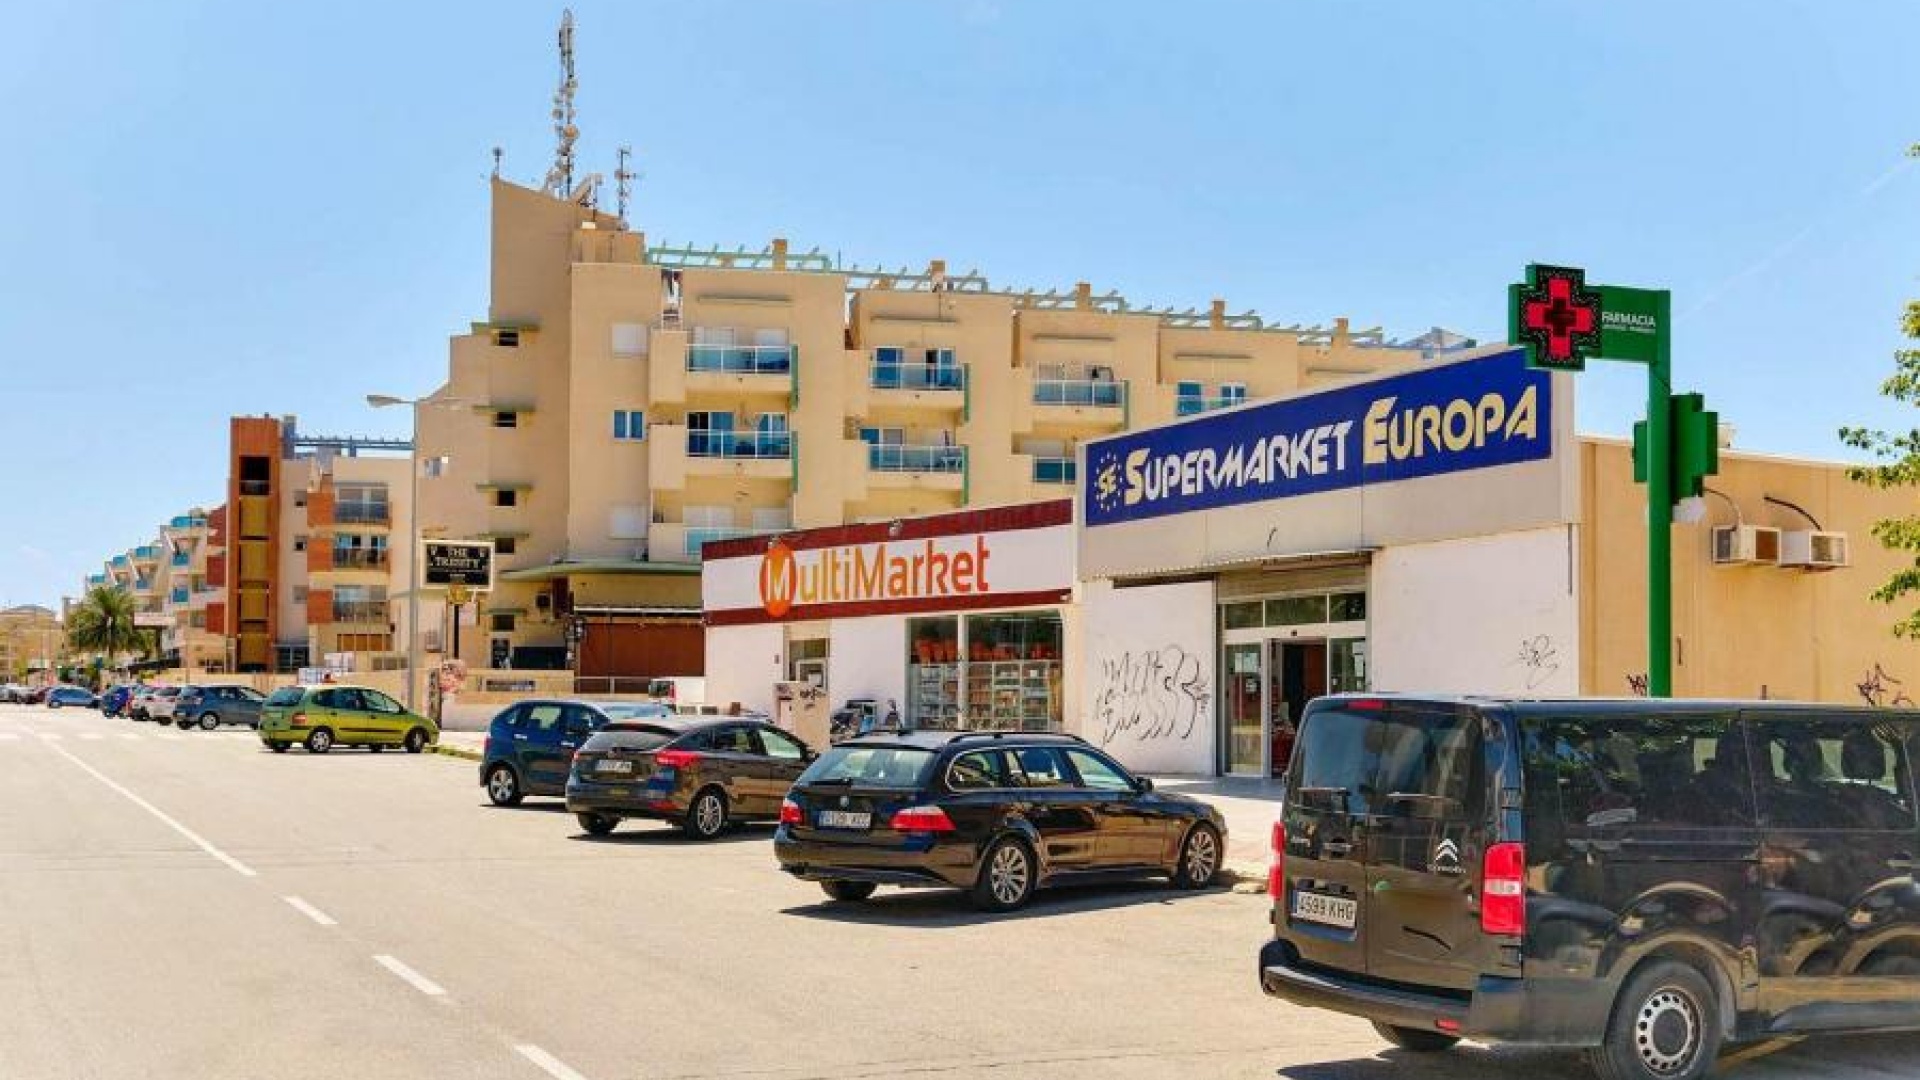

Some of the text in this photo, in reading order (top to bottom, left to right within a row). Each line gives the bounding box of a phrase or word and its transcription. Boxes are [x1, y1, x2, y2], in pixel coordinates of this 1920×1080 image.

[1602, 311, 1656, 327] FARMACIA
[1123, 419, 1353, 505] SUPERMARKET
[1363, 386, 1537, 464] EUROPA
[764, 535, 990, 604] MultiMarket
[1328, 901, 1354, 921] KHG
